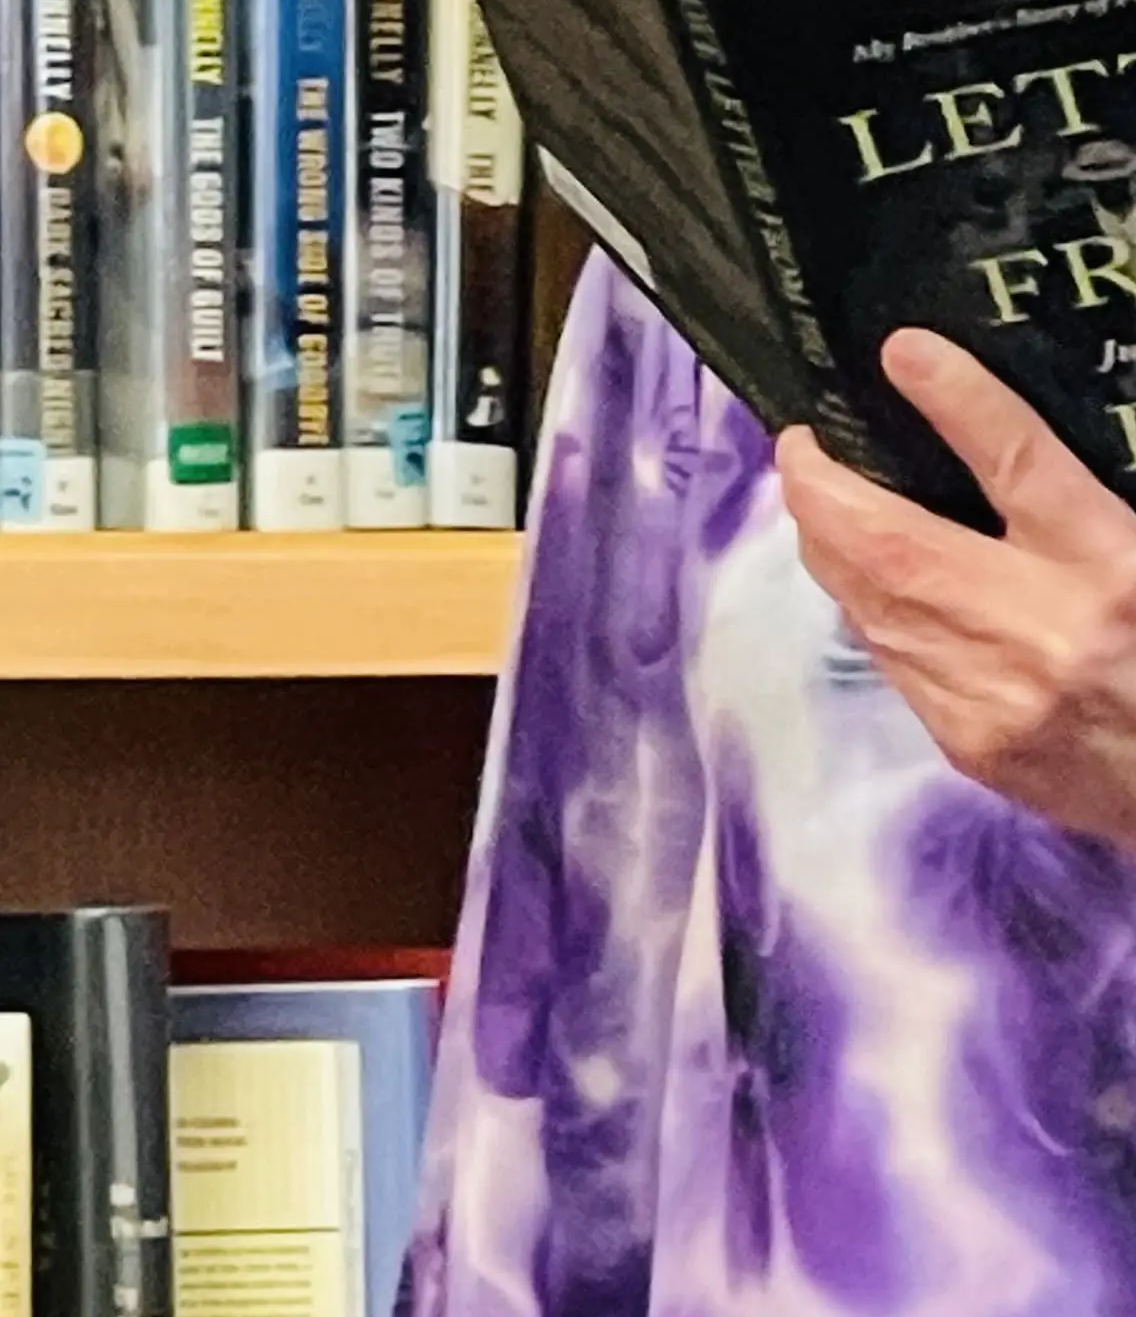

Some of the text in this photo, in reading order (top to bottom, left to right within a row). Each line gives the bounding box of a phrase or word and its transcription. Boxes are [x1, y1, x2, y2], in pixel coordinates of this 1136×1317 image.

[296, 78, 330, 118] THE
[296, 129, 330, 220] WRONG
[370, 111, 405, 168] TWO
[370, 177, 405, 257] KINDS
[704, 72, 776, 203] LETTER
[751, 210, 810, 305] FROM
[190, 116, 223, 362] THE GODS OF GUILT
[296, 230, 330, 282] SIDE
[40, 267, 75, 370] SACRED
[296, 293, 330, 321] OF
[372, 268, 405, 303] OF
[296, 333, 330, 445] GOODBYE
